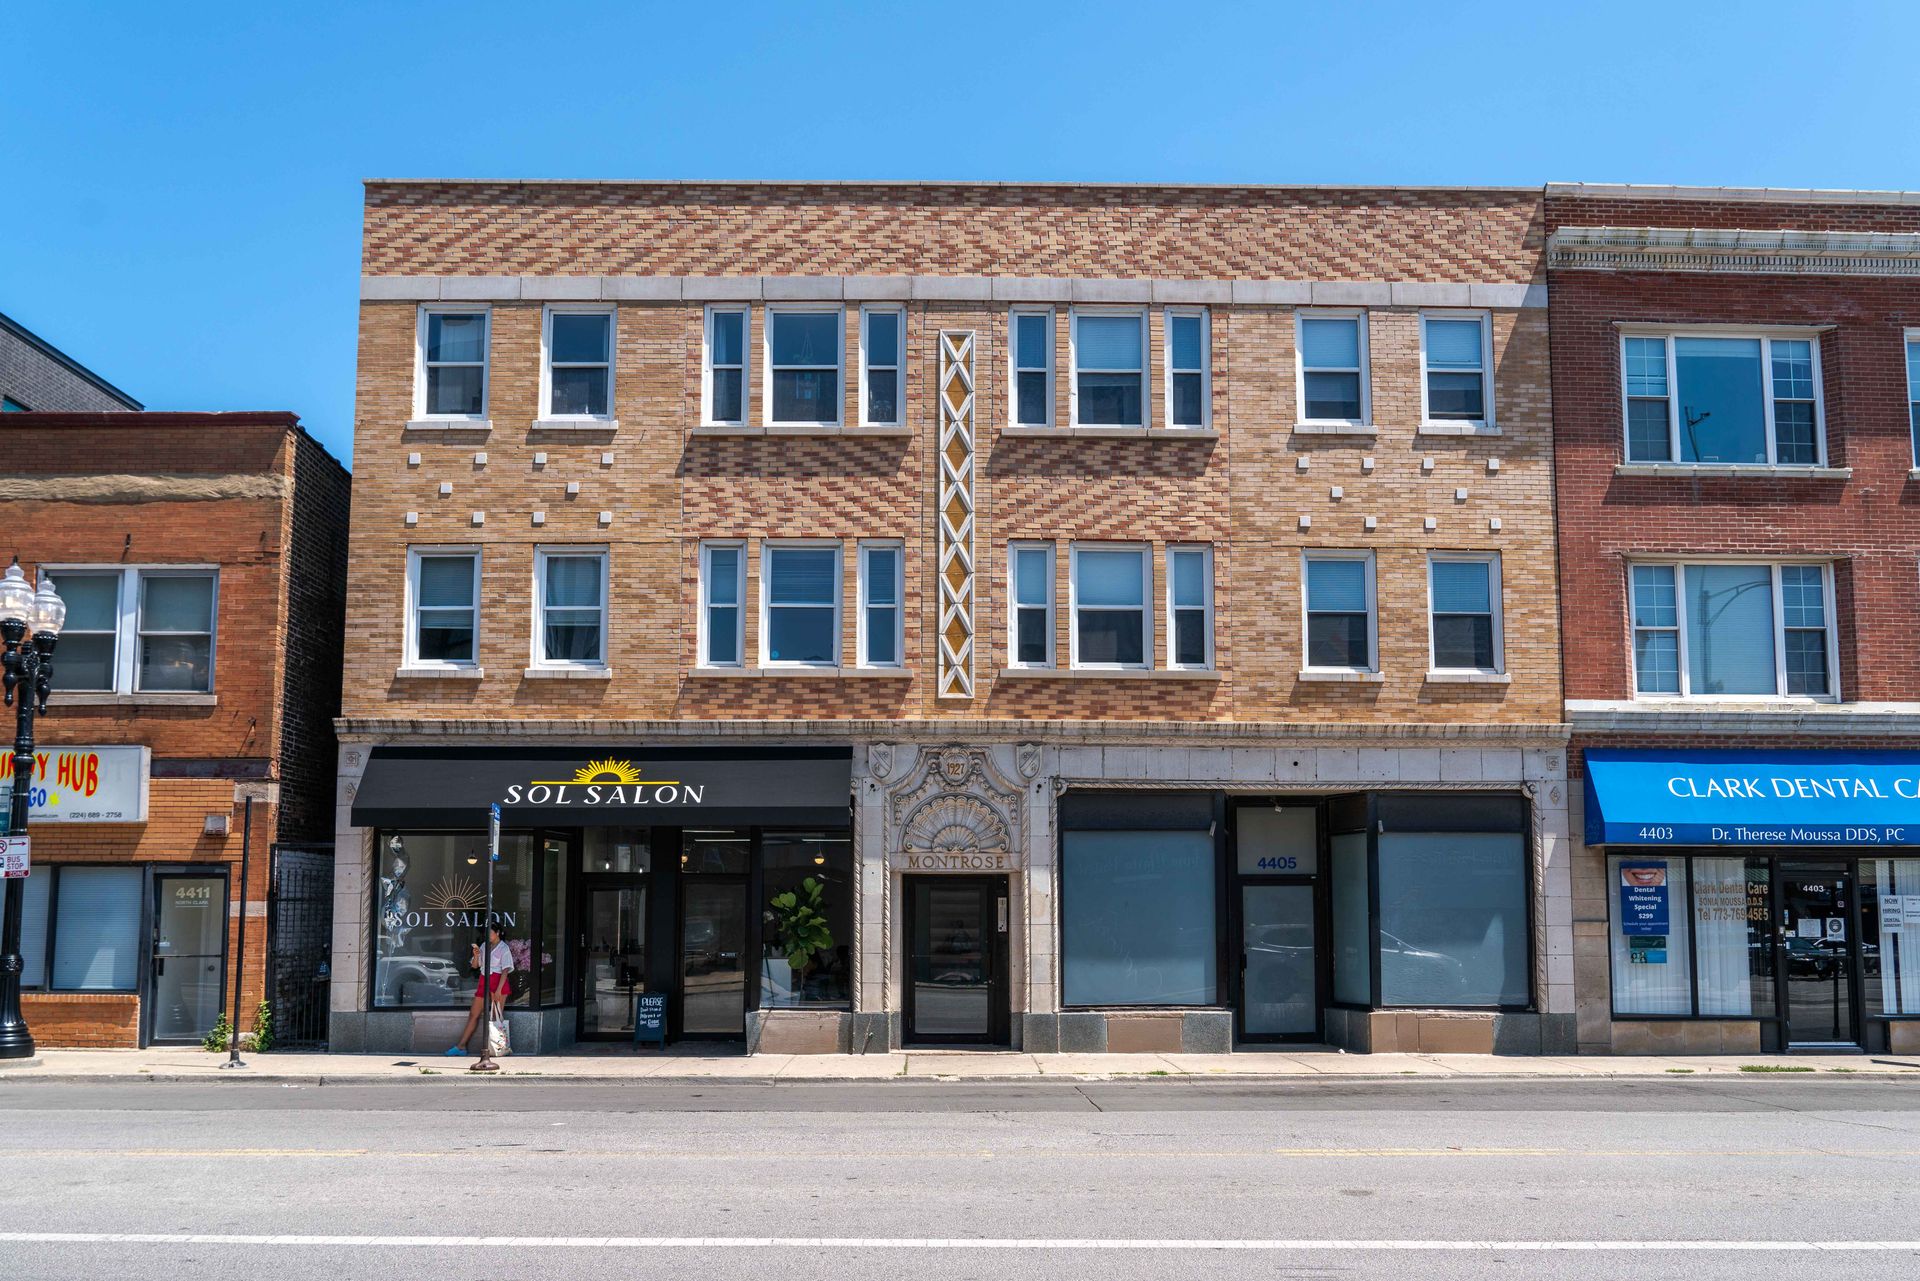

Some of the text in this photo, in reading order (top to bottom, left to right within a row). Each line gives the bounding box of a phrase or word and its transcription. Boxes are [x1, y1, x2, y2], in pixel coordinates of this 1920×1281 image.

[57, 752, 99, 798] HUB
[947, 763, 965, 775] 1927
[503, 784, 705, 805] SOL SALON
[1667, 777, 1920, 798] CLARK DENTAL C
[28, 787, 47, 808] GO
[1639, 827, 1905, 842] 4403 Dr. Therese Moussa DDS, PC
[908, 855, 1004, 868] MONTROSE
[1257, 856, 1297, 870] 4405
[176, 887, 210, 898] 4411
[1747, 882, 1768, 894] Care
[394, 911, 433, 927] SOL
[1697, 908, 1711, 920] Tel
